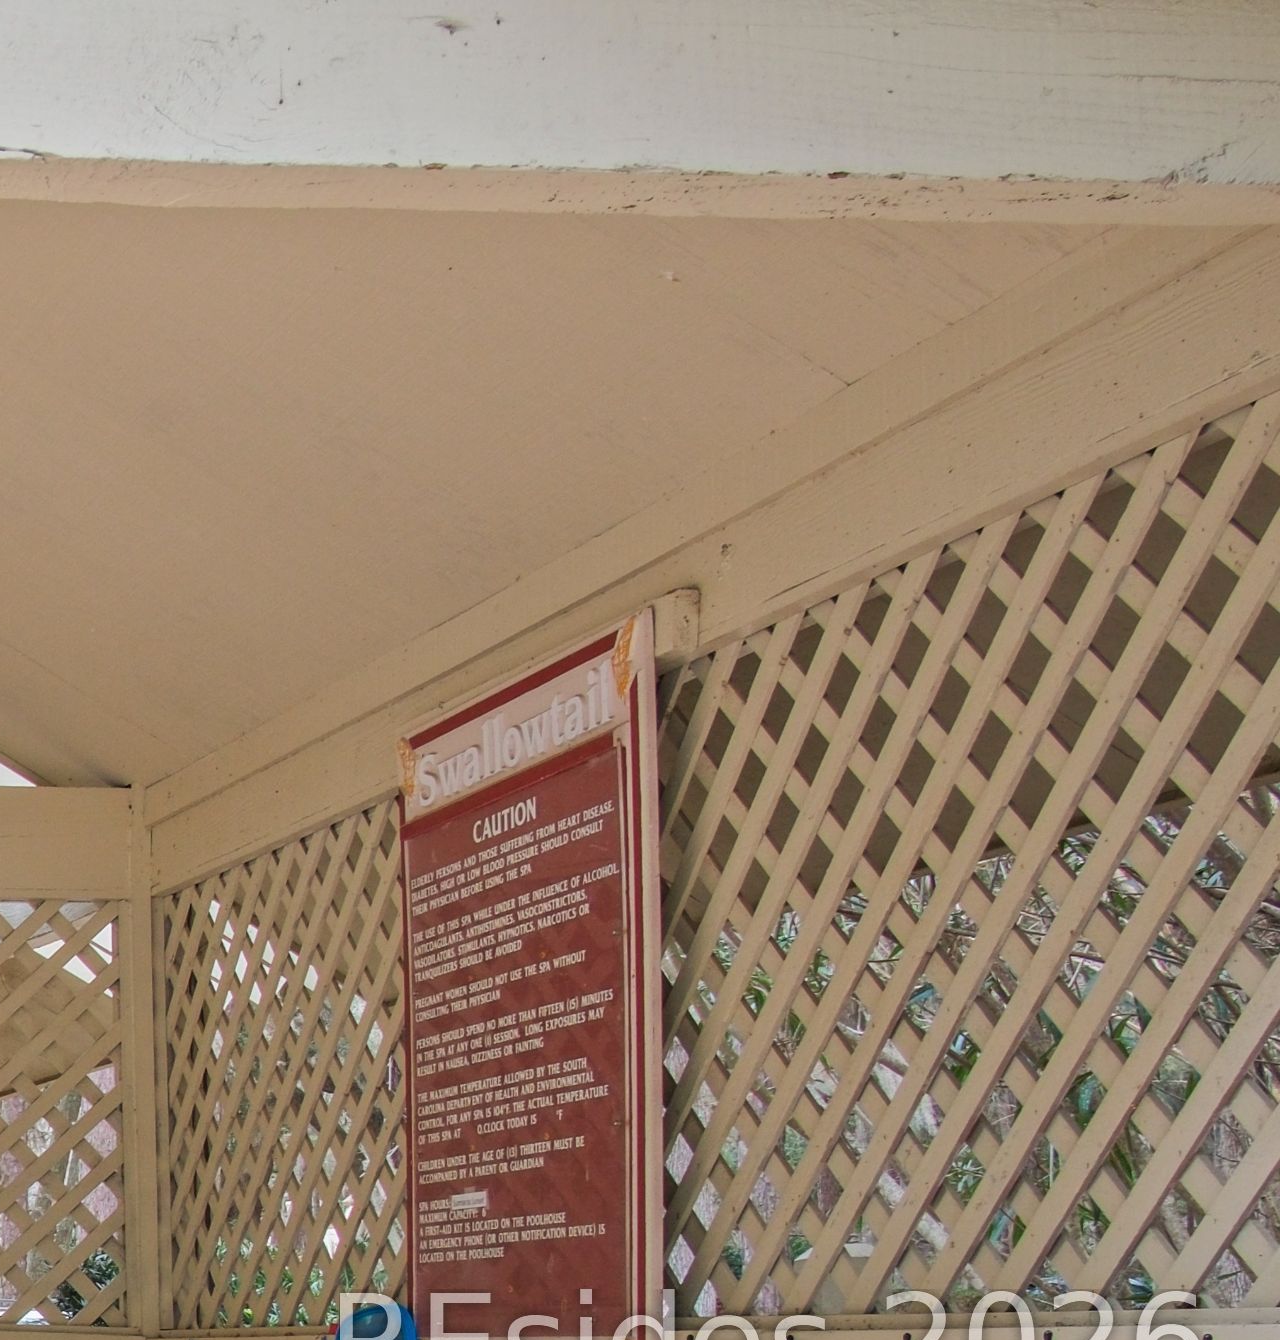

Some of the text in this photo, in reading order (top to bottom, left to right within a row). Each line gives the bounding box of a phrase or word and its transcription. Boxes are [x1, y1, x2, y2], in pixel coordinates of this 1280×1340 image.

[419, 663, 614, 806] Swallowtail
[473, 797, 536, 845] CAUTION
[412, 813, 580, 891] ELDERLY PERSONS AND THOSE SUFFERING FROM HEART
[457, 819, 603, 886] OR LOW BLOOD PRESSURE SHOULD CONSULT
[413, 863, 532, 917] THEIR PHYSICIAN BEFORE USING THE SPA
[414, 875, 580, 944] THE USE OF THIS SPA WHILE UNDER THE INFLUENCE OF
[538, 903, 589, 930] NARCOTICS OR
[460, 953, 483, 969] SHOULD
[486, 949, 492, 961] BE
[495, 940, 522, 958] AVOIDED
[415, 950, 585, 1010] PREGNANT WOMEN SHOULD NOT USE THE SPA WITHOUT
[416, 990, 500, 1023] CONSULTING THEIR PHYSICIAN
[416, 1034, 440, 1050] PERSONS
[442, 1027, 464, 1043] SHOULD
[467, 1022, 485, 1037] SPEND
[487, 1019, 496, 1032] NO
[498, 1014, 516, 1029] MORE
[519, 1009, 536, 1024] THAN
[539, 1001, 564, 1019] FIFTEEN
[581, 989, 613, 1008] MINUTES
[417, 1053, 422, 1063] IN
[425, 1050, 434, 1061] THE
[436, 1047, 446, 1058] SPA
[448, 1045, 455, 1056] AT
[456, 1041, 468, 1054] ANY
[470, 1038, 482, 1050] ONE
[525, 1022, 543, 1037] LONG
[546, 1012, 586, 1032] EXPOSURES
[588, 1007, 604, 1022] MAY
[417, 1038, 544, 1077] RESULT IN DIZZINESS OR FAINTING
[418, 1092, 428, 1103] THE
[460, 1076, 501, 1094] TEMPERATURE
[504, 1069, 534, 1085] ALLOWED
[536, 1067, 545, 1079] BY
[548, 1064, 560, 1076] THE
[563, 1058, 588, 1073] SOUTH
[418, 1072, 593, 1117] CAROLINA OF HEALTH AND ENVIRONMENTAL
[447, 1085, 608, 1126] FOR ANY SPA IS THE ACTUAL TEMPERATURE
[418, 1115, 537, 1145] OF THIS SPA AT TODAY IS
[418, 1158, 445, 1171] CHILDREN
[447, 1155, 466, 1167] UNDER
[469, 1153, 480, 1164] THE
[482, 1151, 494, 1162] AGE
[496, 1149, 504, 1160] OF
[520, 1142, 551, 1157] THIRTEEN
[554, 1139, 573, 1152] MUST
[576, 1137, 584, 1148] BE
[419, 1169, 458, 1184] ACCOMPANIED
[459, 1168, 466, 1179] BY
[475, 1164, 497, 1177] PARENT
[499, 1162, 508, 1173] OR
[510, 1157, 544, 1172] GUARDIAN
[419, 1202, 428, 1212] SPA
[454, 1223, 462, 1233] KIT
[465, 1222, 470, 1232] IS
[472, 1220, 499, 1232] LOCATED
[501, 1218, 510, 1229] ON
[513, 1217, 524, 1228] THE
[527, 1213, 566, 1227] POOLHOUSE
[420, 1240, 427, 1250] AN
[429, 1237, 462, 1249] EMERGENCY
[464, 1235, 483, 1246] PHONE
[499, 1232, 519, 1244] OTHER
[522, 1228, 566, 1242] NOTIFICATION
[599, 1225, 605, 1236] IS
[420, 1247, 504, 1263] LOCATED ON THE POOLHOUSE
